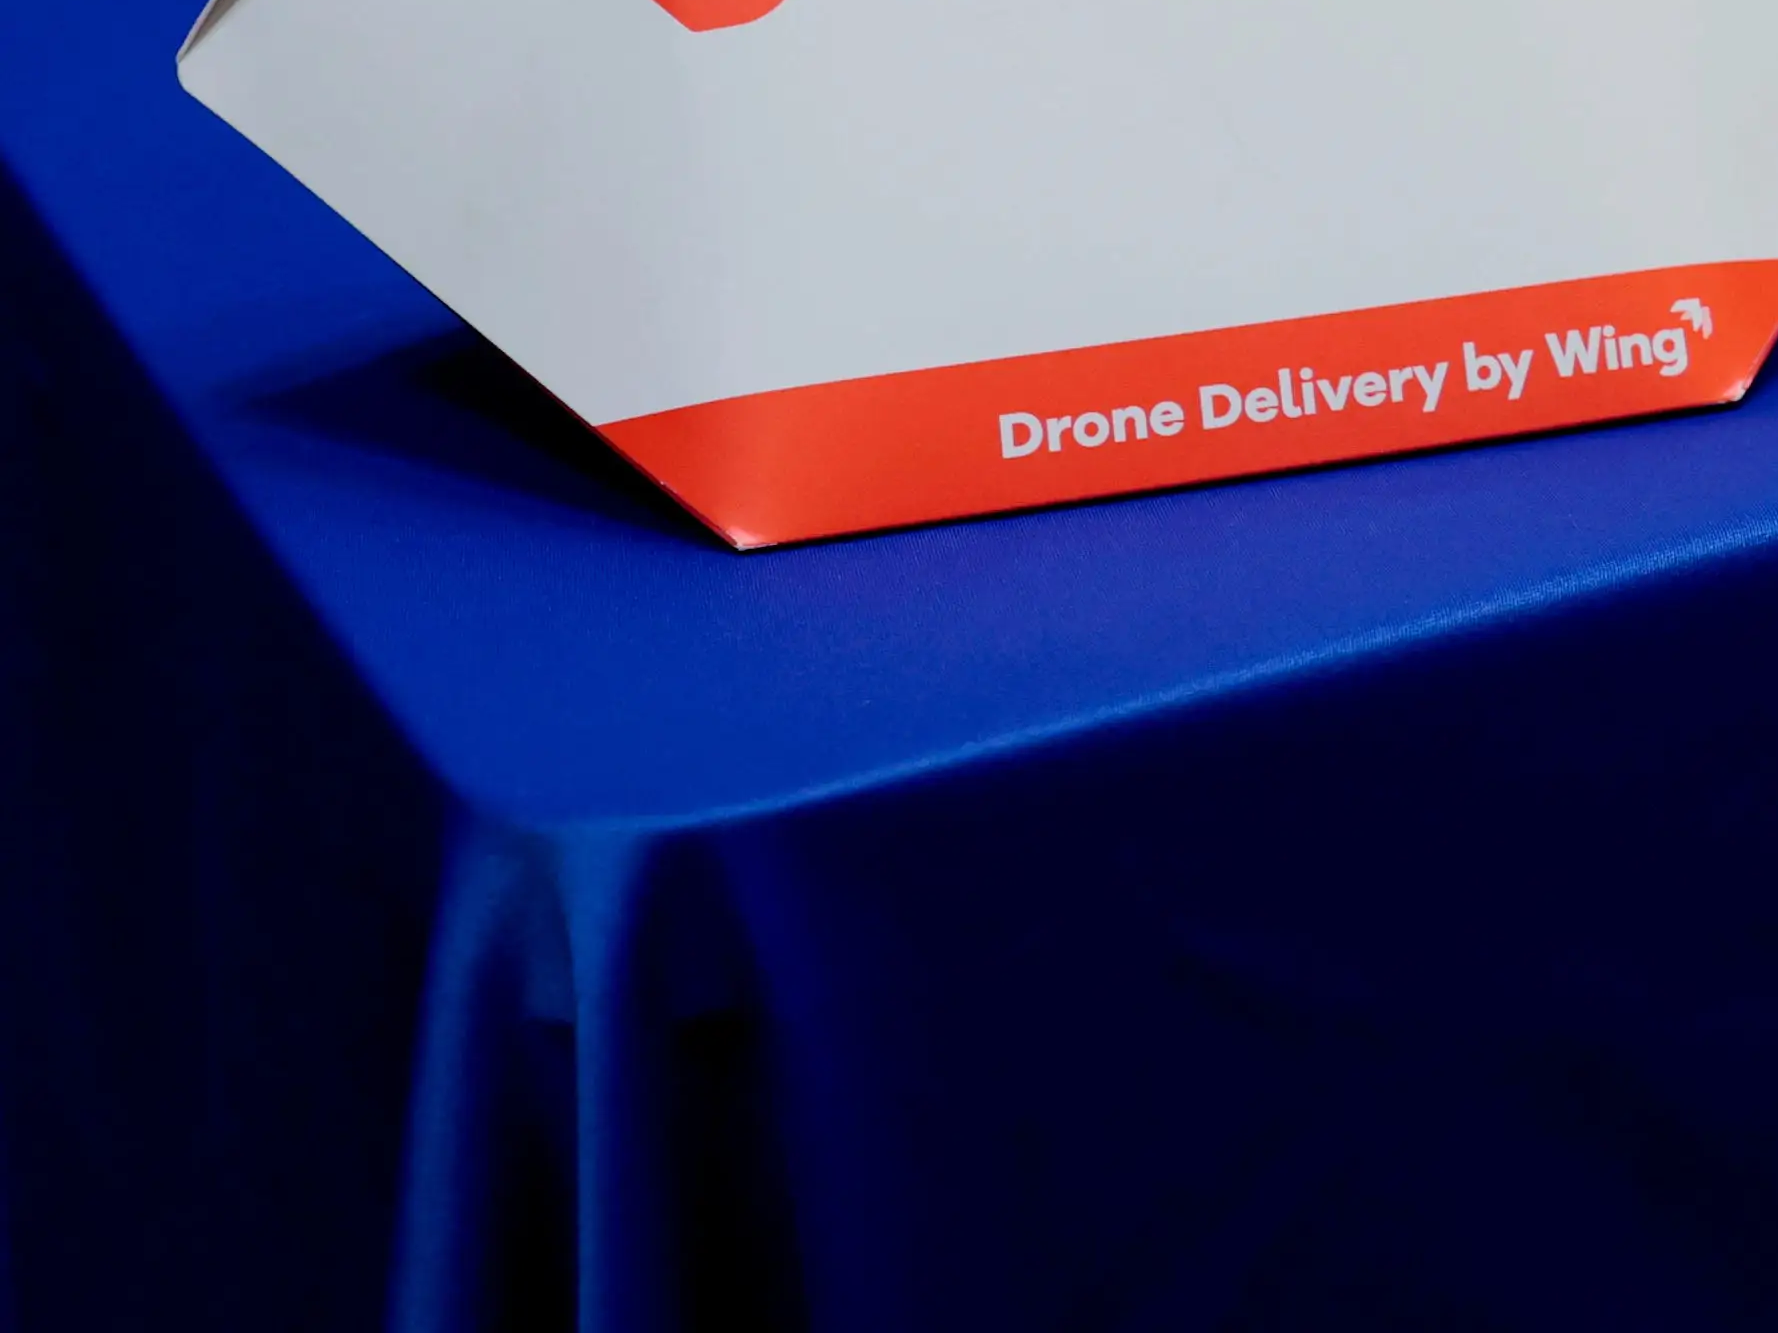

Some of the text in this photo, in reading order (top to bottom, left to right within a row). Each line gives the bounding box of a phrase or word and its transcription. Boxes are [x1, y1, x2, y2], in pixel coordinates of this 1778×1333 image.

[997, 323, 1690, 460] Drone Delivery by Wing
